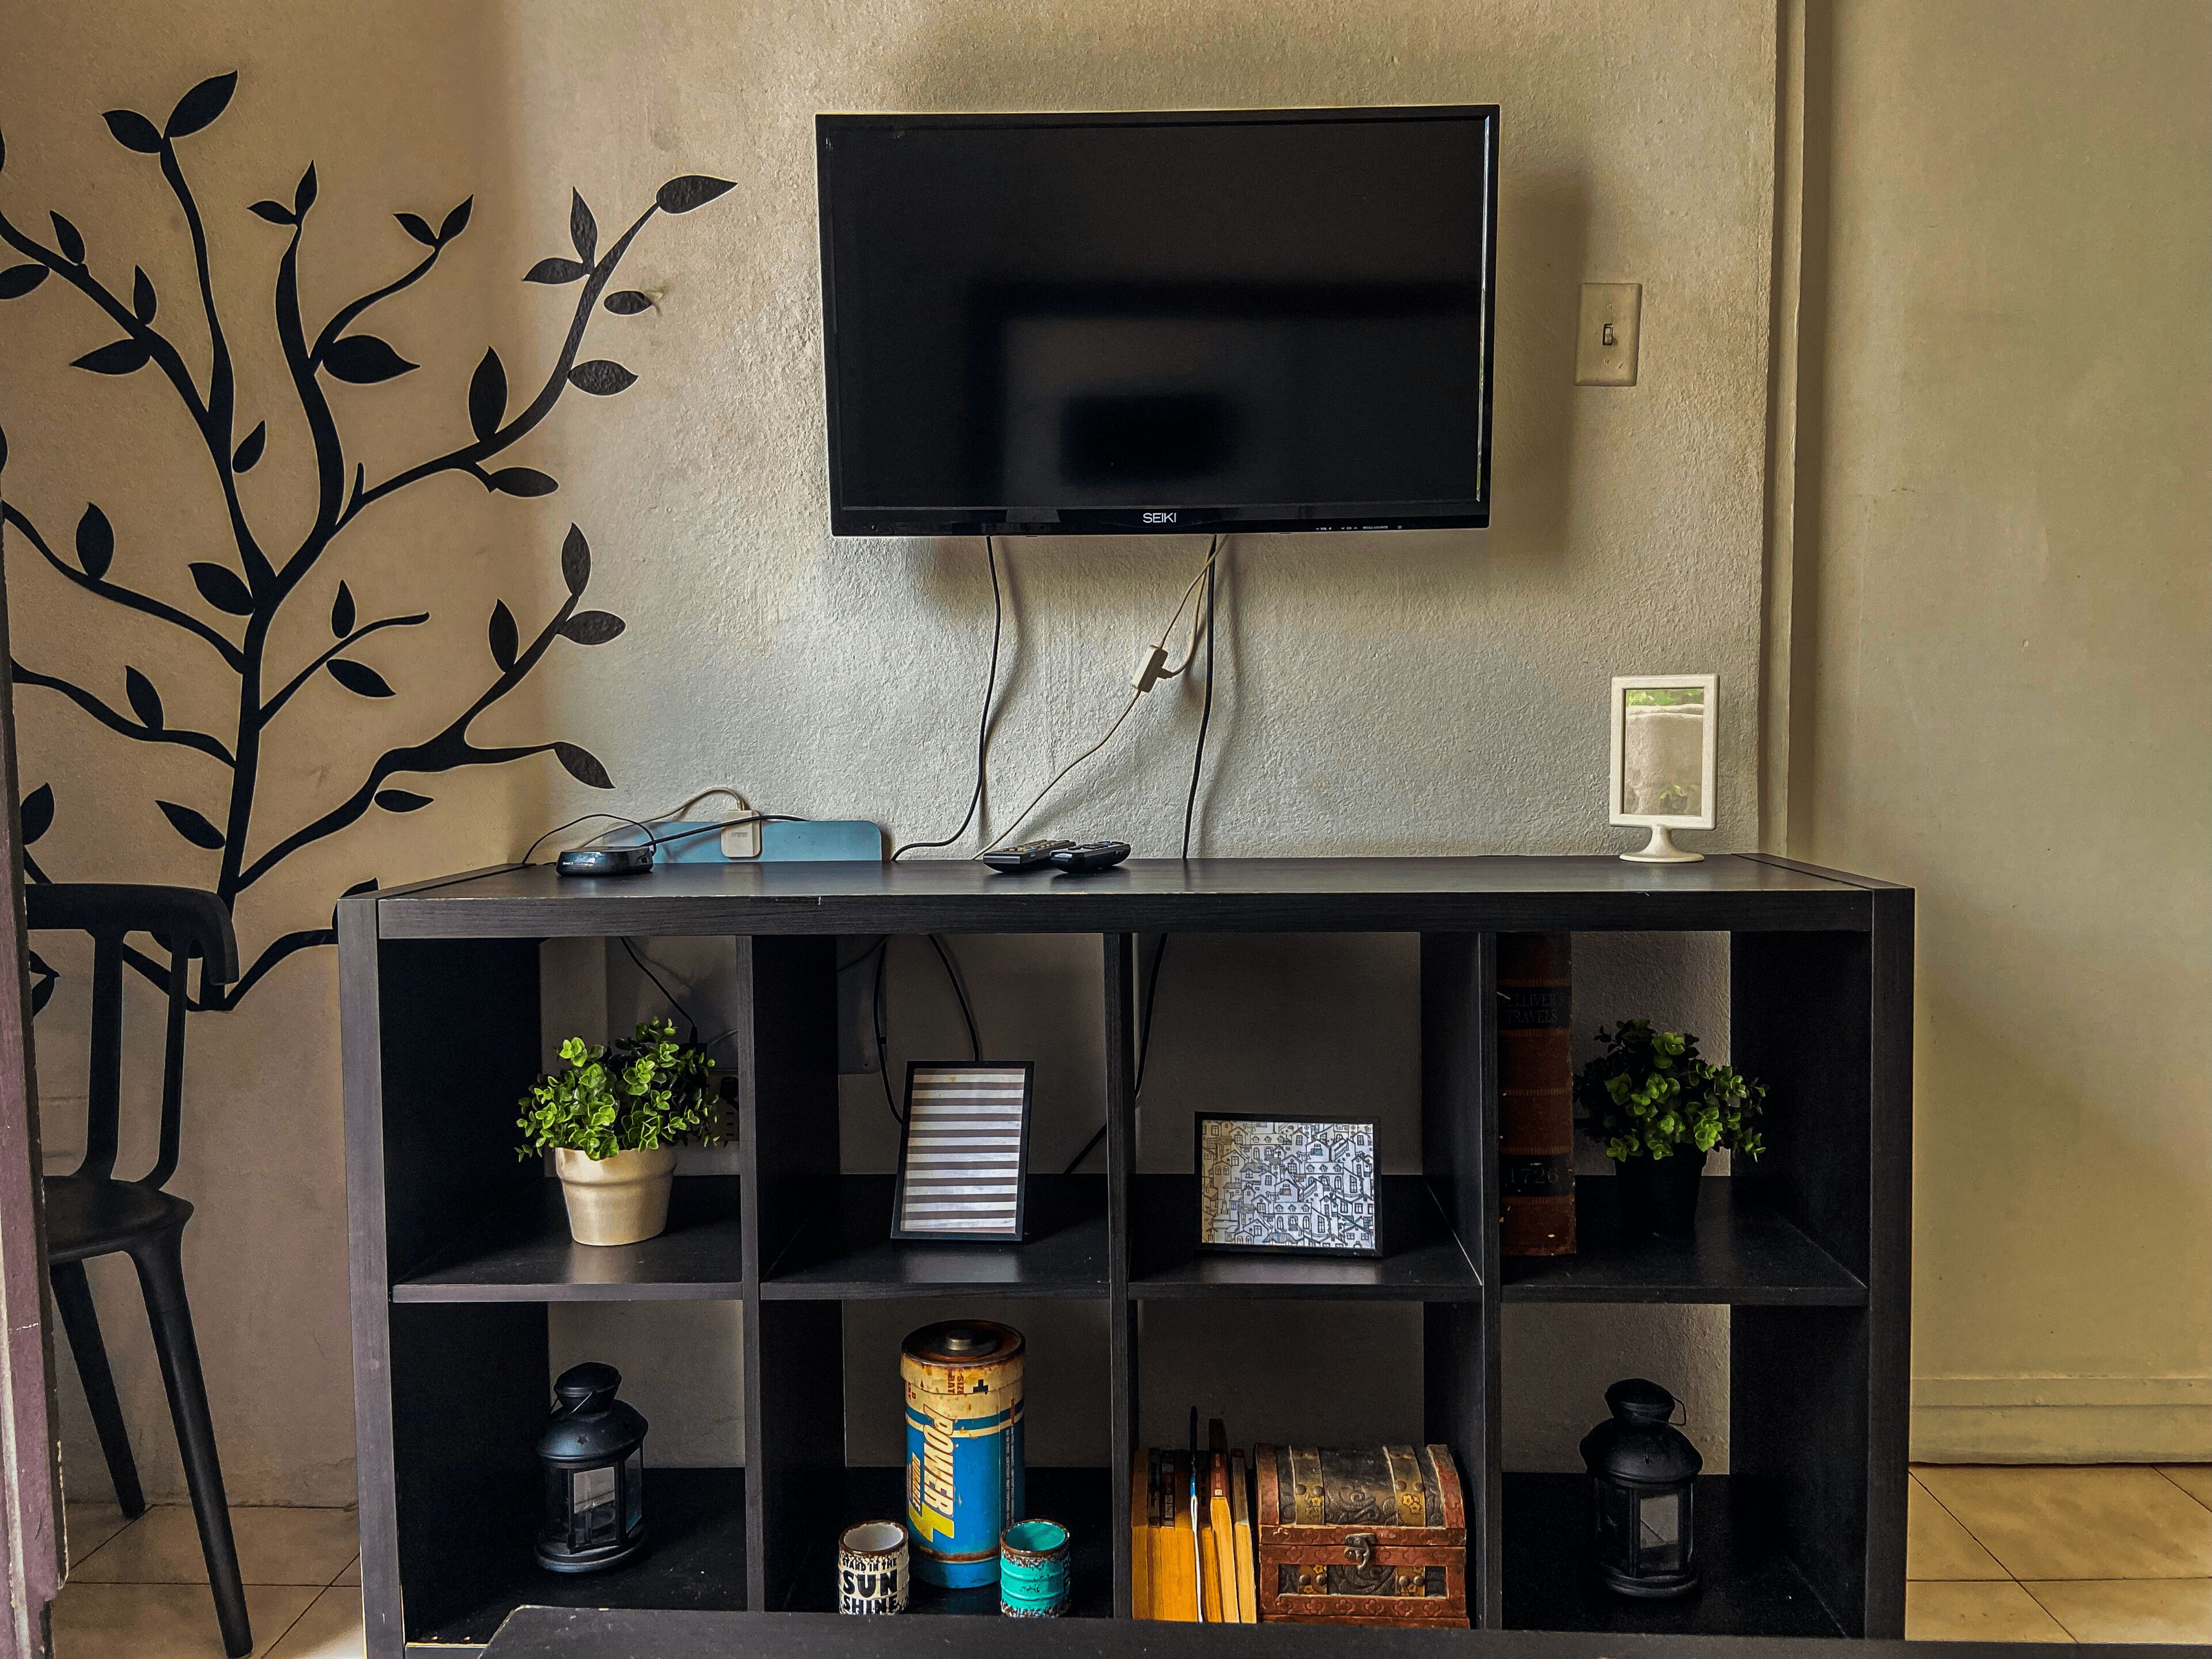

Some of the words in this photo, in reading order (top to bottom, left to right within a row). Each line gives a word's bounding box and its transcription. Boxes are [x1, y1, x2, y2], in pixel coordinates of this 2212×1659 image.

[1143, 513, 1176, 523] SEIKI
[1505, 1009, 1558, 1023] TRAVELS
[1511, 1166, 1559, 1184] 1726
[923, 1404, 955, 1516] POWER
[912, 1452, 921, 1512] DURABLE
[843, 1558, 866, 1571] STAND
[869, 1560, 879, 1571] IN
[882, 1558, 897, 1570] THE
[843, 1569, 897, 1598] SUN
[843, 1594, 899, 1615] SHINE
